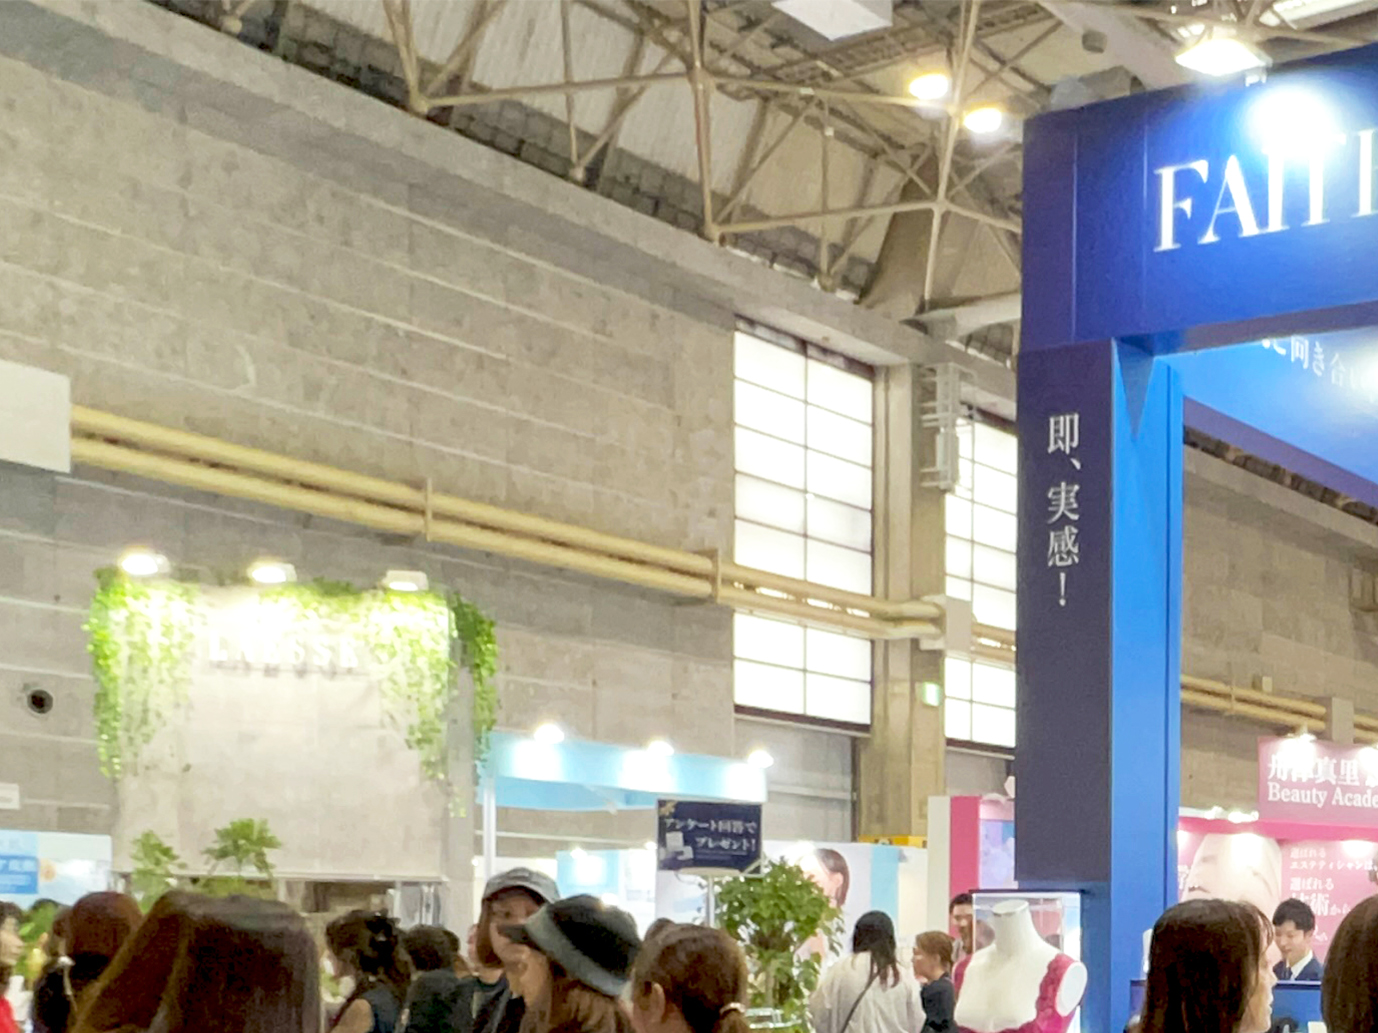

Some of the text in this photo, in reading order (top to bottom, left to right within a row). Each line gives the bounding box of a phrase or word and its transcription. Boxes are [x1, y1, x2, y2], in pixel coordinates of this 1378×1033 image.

[1047, 412, 1082, 607] 即、実感！
[1267, 781, 1328, 808] Beauty
